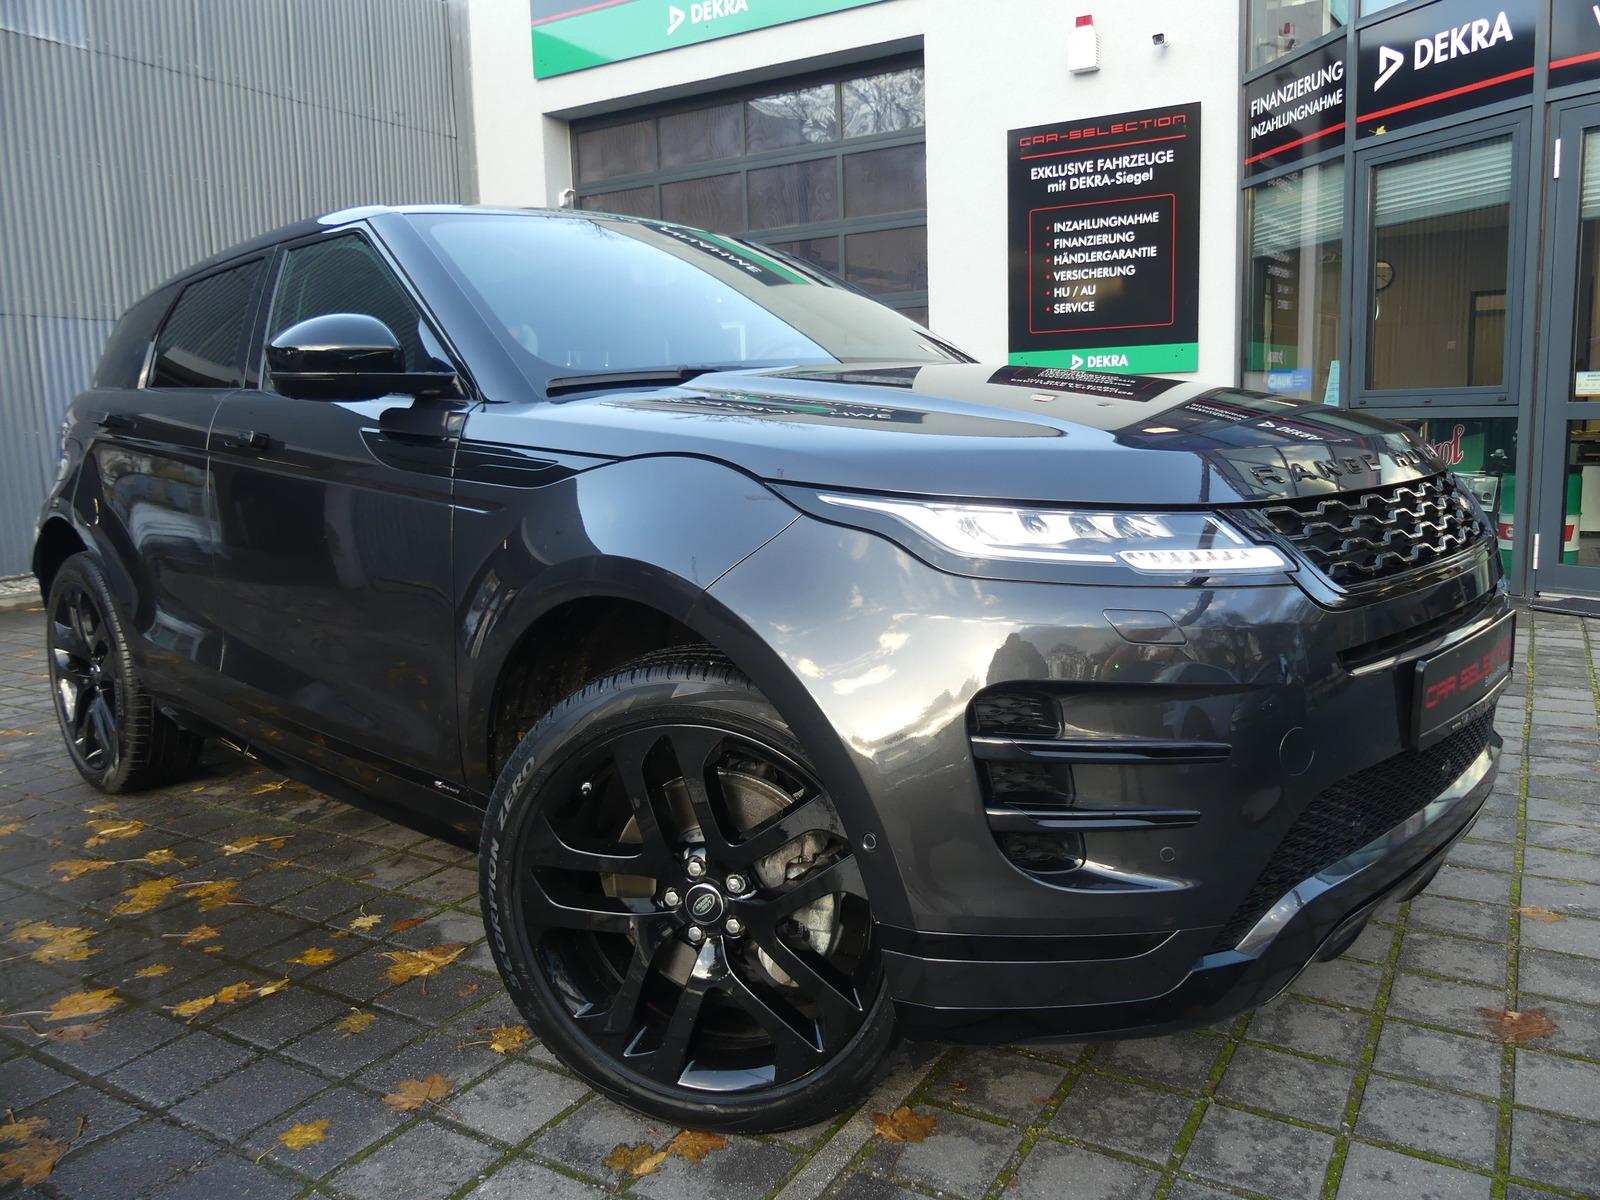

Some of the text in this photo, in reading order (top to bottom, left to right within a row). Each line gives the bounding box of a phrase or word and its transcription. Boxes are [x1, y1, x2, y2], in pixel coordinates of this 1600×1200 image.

[690, 0, 749, 24] DEKRA
[1413, 11, 1513, 71] DEKRA
[1250, 60, 1344, 118] FINANZIERUNG
[1250, 88, 1343, 140] INZAHLUNGNAHME
[1018, 113, 1187, 148] CAR-SELECTION
[1030, 150, 1175, 181] EXKLUSIVE FAHRZEUGE
[1047, 168, 1153, 193] mit DEKRA-Siegel
[1053, 211, 1160, 233] INZAHLUNGNAHME
[1053, 231, 1135, 250] FINANZIERUNG
[1053, 245, 1158, 266] HÄNDLERGARANTIE
[1053, 264, 1136, 282] VERSICHERUNG
[1053, 287, 1070, 298] HU
[1080, 284, 1097, 296] AU
[1053, 301, 1095, 315] SERVICE
[1087, 354, 1129, 368] DEKRA
[488, 756, 535, 991] SCORPION ZERO
